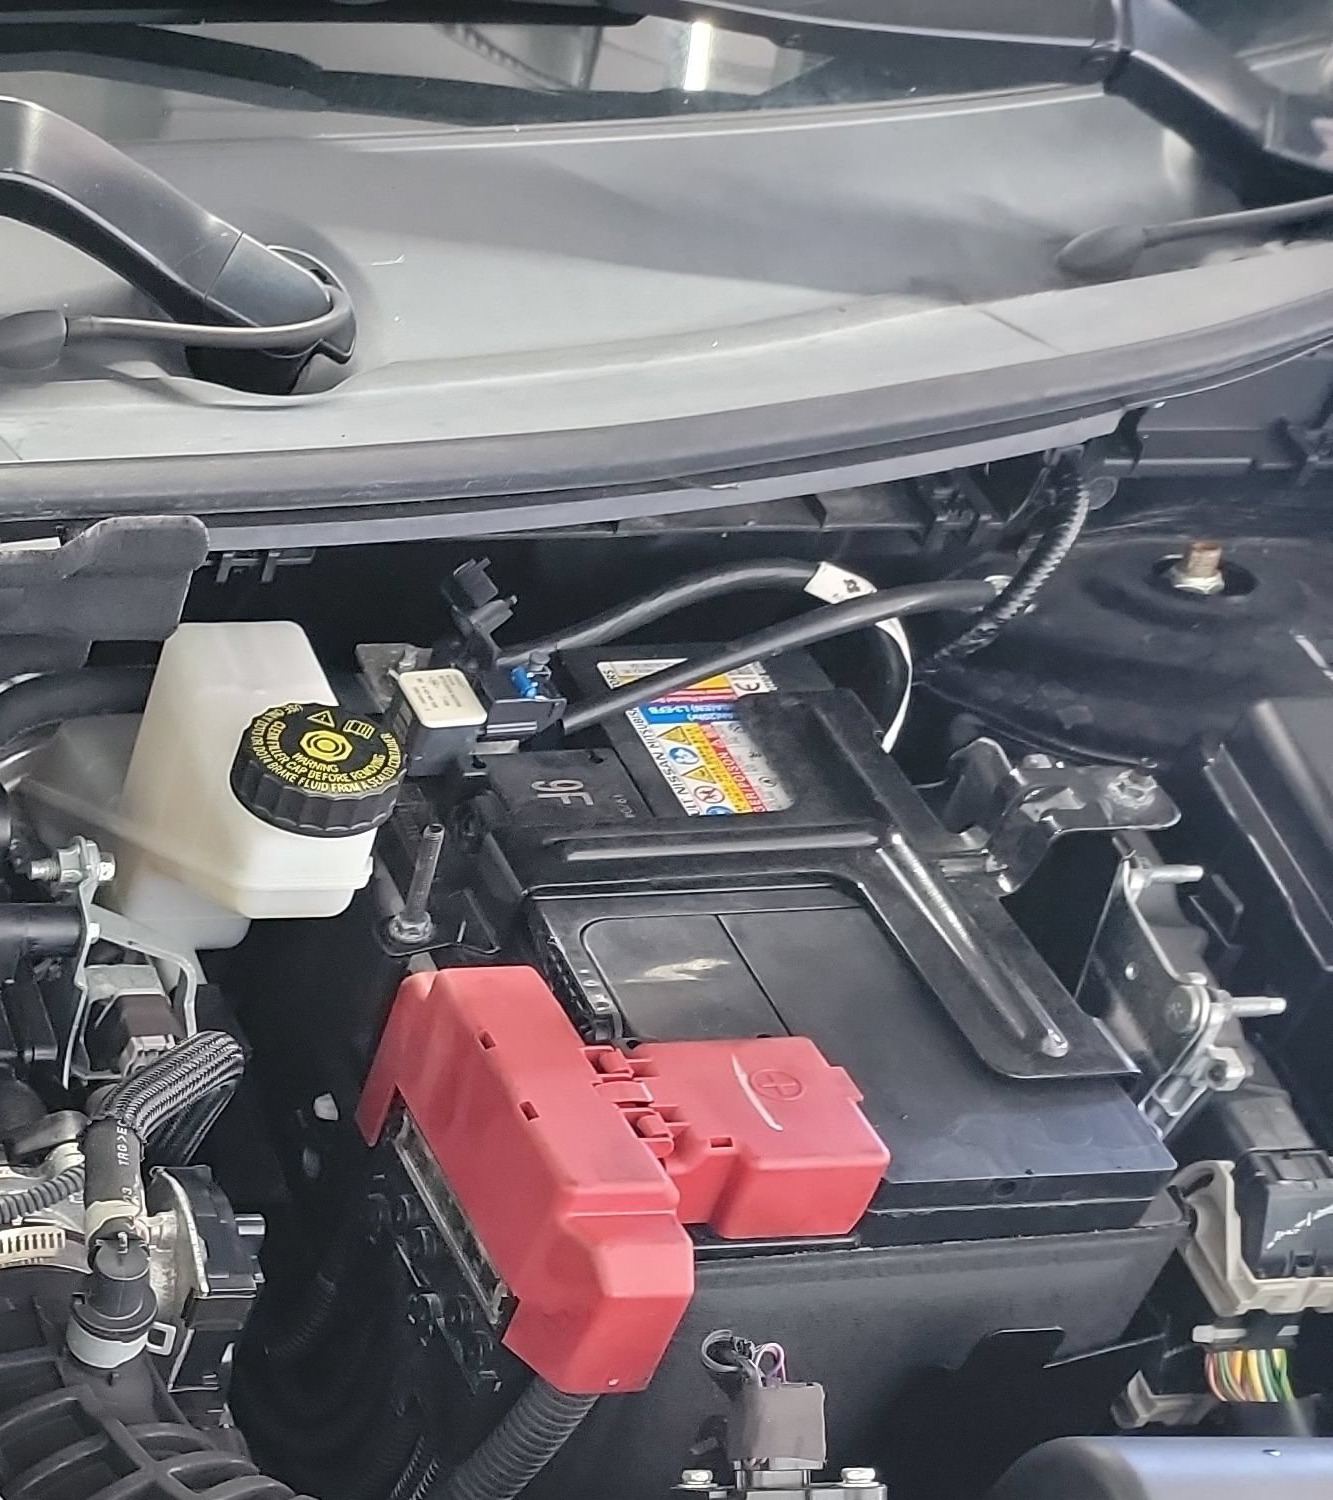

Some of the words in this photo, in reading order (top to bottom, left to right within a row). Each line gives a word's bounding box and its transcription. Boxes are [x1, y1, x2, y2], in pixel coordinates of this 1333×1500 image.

[267, 761, 299, 783] BRAKE
[298, 777, 329, 792] FLUID
[331, 782, 361, 793] FROM
[286, 760, 308, 774] CAP
[308, 771, 351, 782] BEFORE
[351, 753, 385, 781] REMOVING
[292, 752, 339, 773] WARNING
[654, 749, 688, 796] NISSAN
